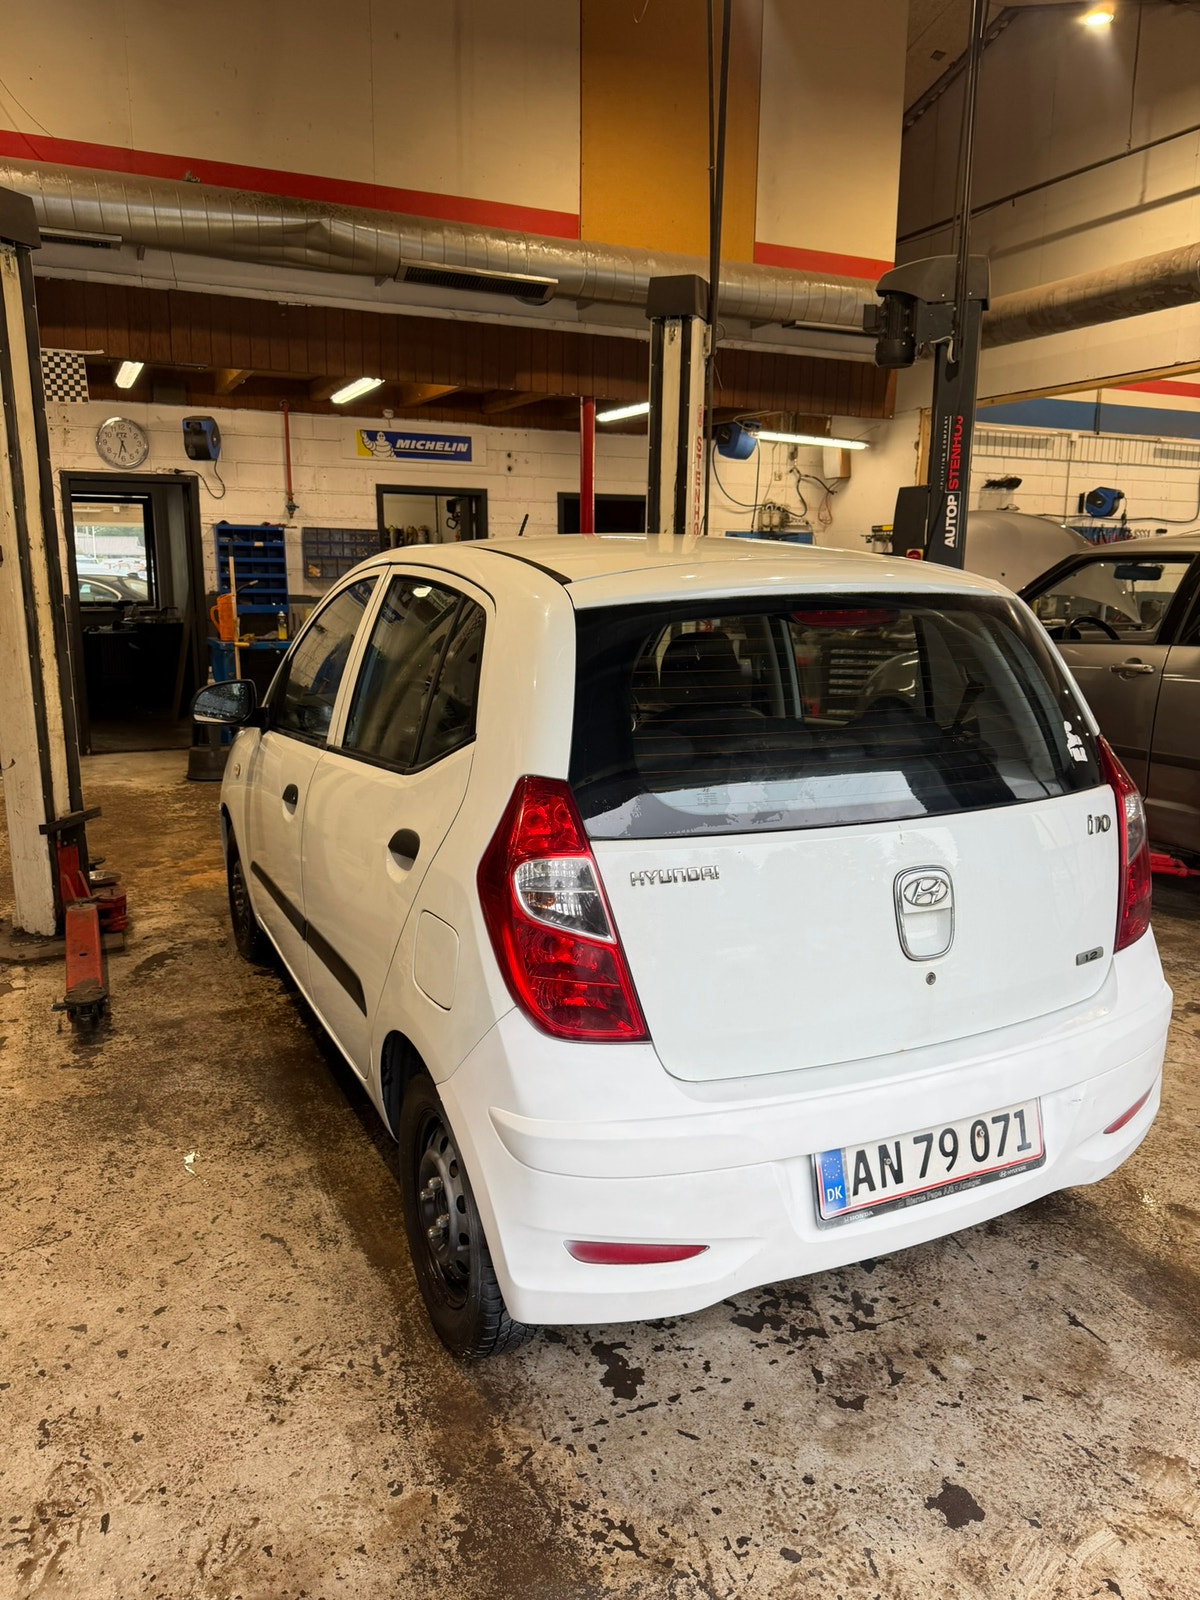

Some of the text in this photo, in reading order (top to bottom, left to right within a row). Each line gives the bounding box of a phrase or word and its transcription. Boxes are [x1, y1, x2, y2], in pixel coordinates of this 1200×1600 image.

[395, 439, 469, 453] MICHELIN
[944, 494, 958, 548] AUTOP
[1087, 814, 1111, 835] i10
[630, 865, 720, 886] HYUNDAI
[852, 1109, 1032, 1197] AN 79 071
[827, 1185, 843, 1202] DK
